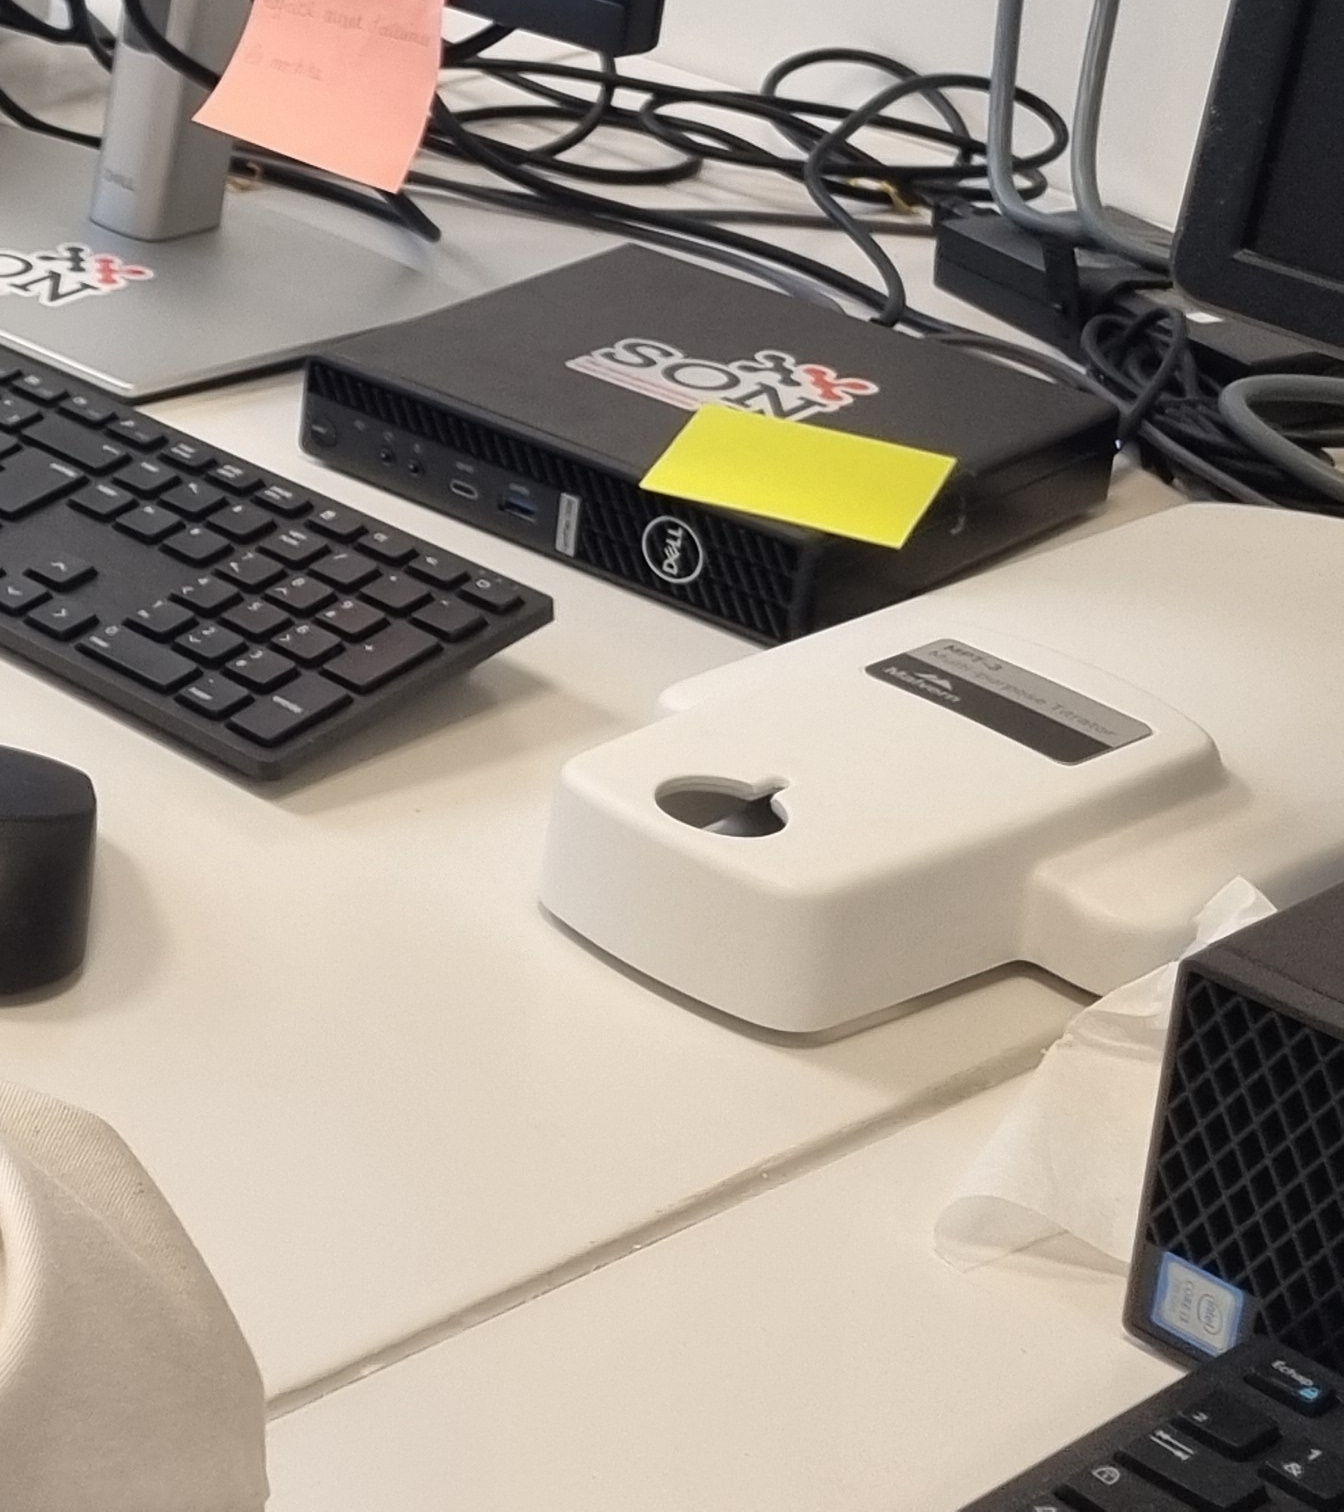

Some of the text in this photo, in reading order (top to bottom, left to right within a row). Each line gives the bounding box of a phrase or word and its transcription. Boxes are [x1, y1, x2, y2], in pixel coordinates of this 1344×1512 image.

[600, 341, 828, 420] SON
[662, 526, 684, 575] DELL
[883, 666, 961, 703] Malvern
